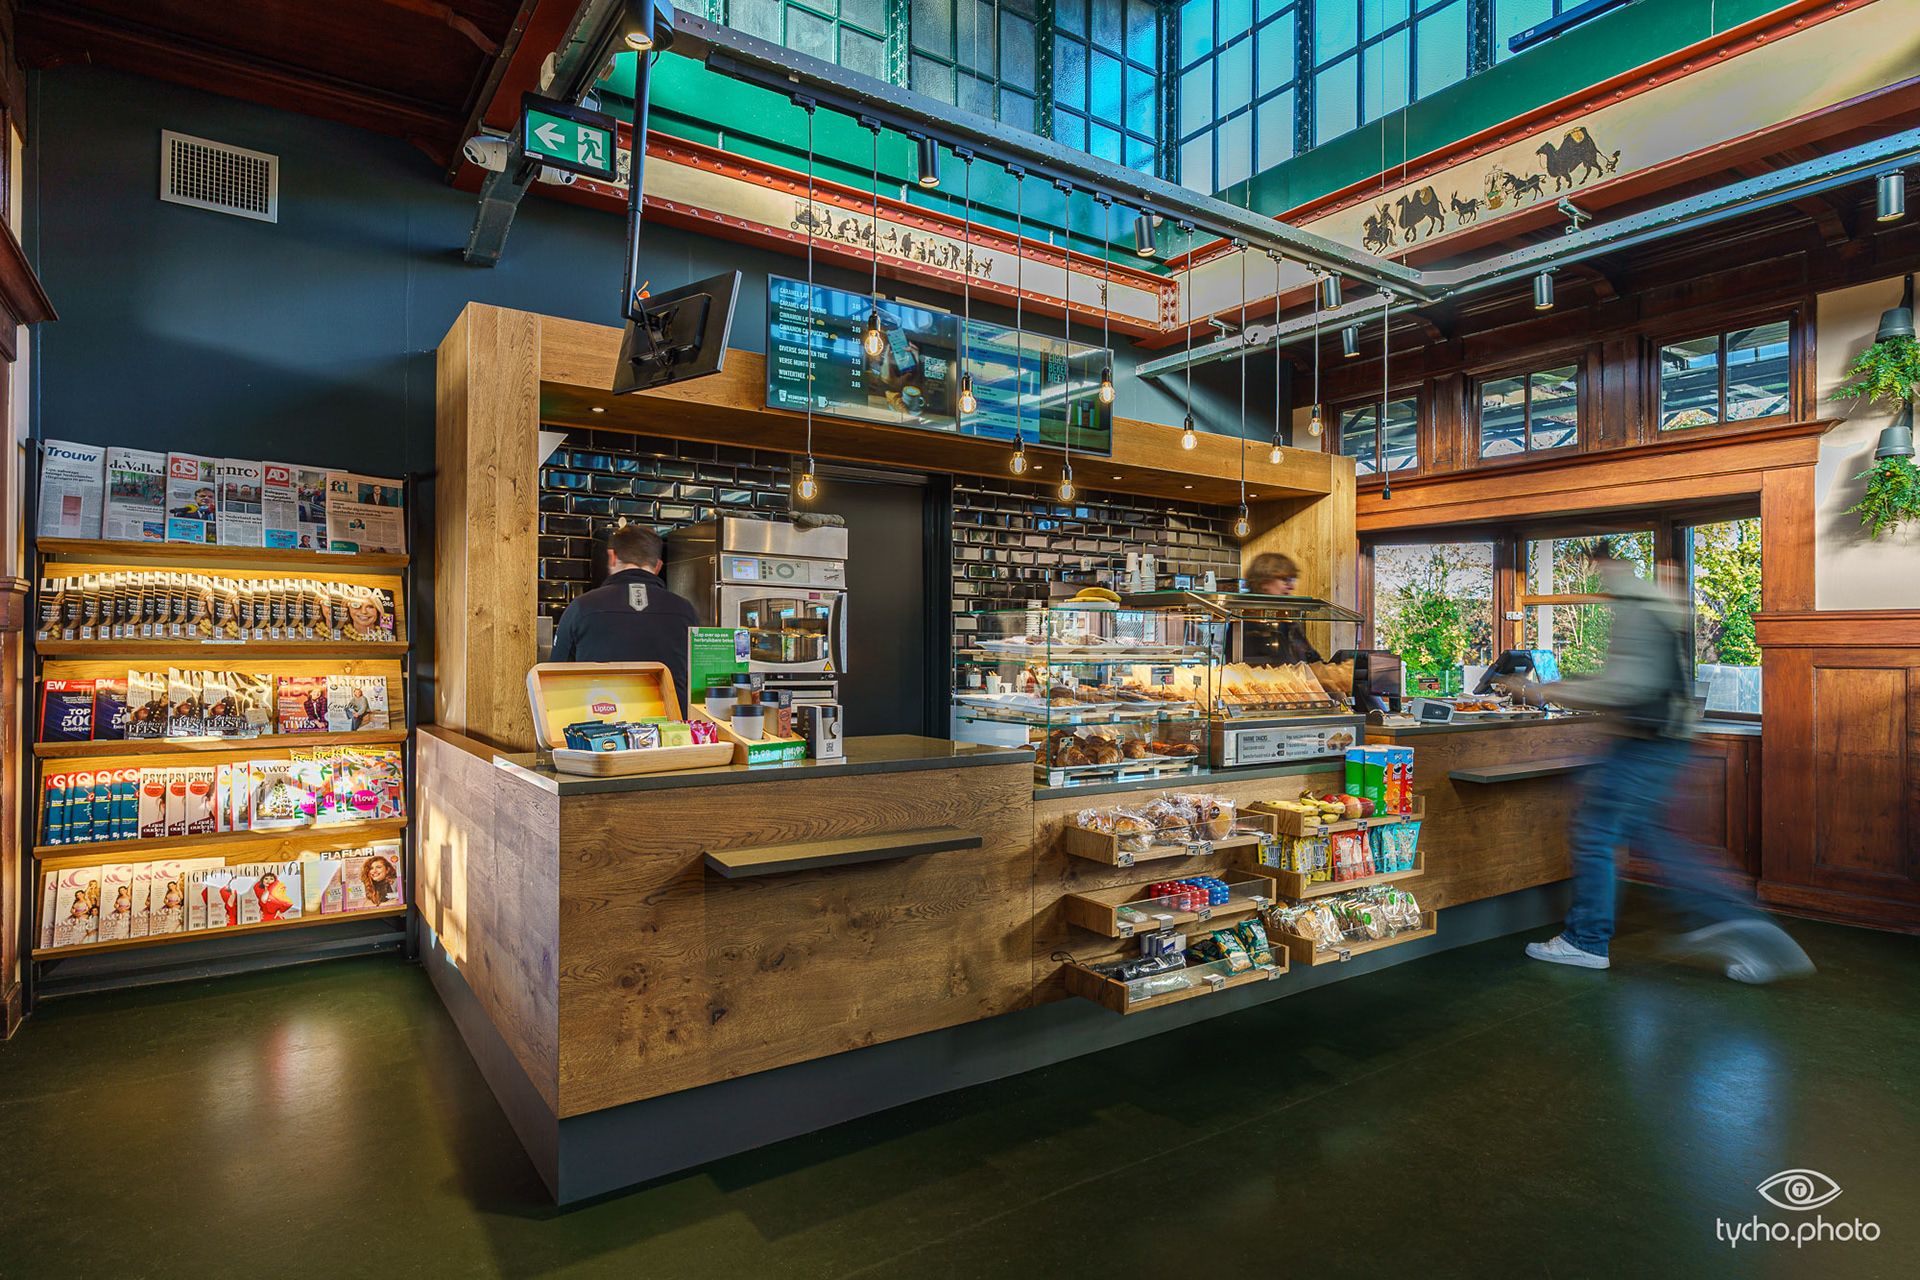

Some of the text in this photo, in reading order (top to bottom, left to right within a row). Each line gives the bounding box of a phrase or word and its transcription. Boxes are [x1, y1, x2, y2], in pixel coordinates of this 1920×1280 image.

[779, 300, 800, 309] CARAMEL
[800, 304, 827, 314] CAPUCCINO
[779, 312, 802, 322] CINNAMON
[802, 315, 815, 324] LATE
[779, 324, 802, 334] CINNAMON
[802, 328, 829, 338] CAPUCCINO
[778, 345, 797, 354] DIVERSE
[797, 348, 817, 357] SOOREN
[817, 351, 828, 359] THEE
[778, 357, 793, 365] VERSE
[793, 359, 816, 369] MUNTTEE
[1047, 372, 1066, 384] MEE?
[47, 446, 97, 462] Trouw
[109, 459, 166, 475] deVolks
[171, 459, 197, 476] dS
[226, 466, 253, 477] nrc
[266, 468, 289, 481] AD
[330, 480, 353, 494] fd.
[46, 681, 66, 690] EW
[95, 679, 115, 688] EW
[328, 675, 386, 689] Margriet
[593, 704, 616, 714] Lipton
[283, 720, 316, 730] TIMES
[750, 749, 771, 759] 13,99
[354, 794, 376, 802] flow
[341, 847, 375, 858] FLAIR
